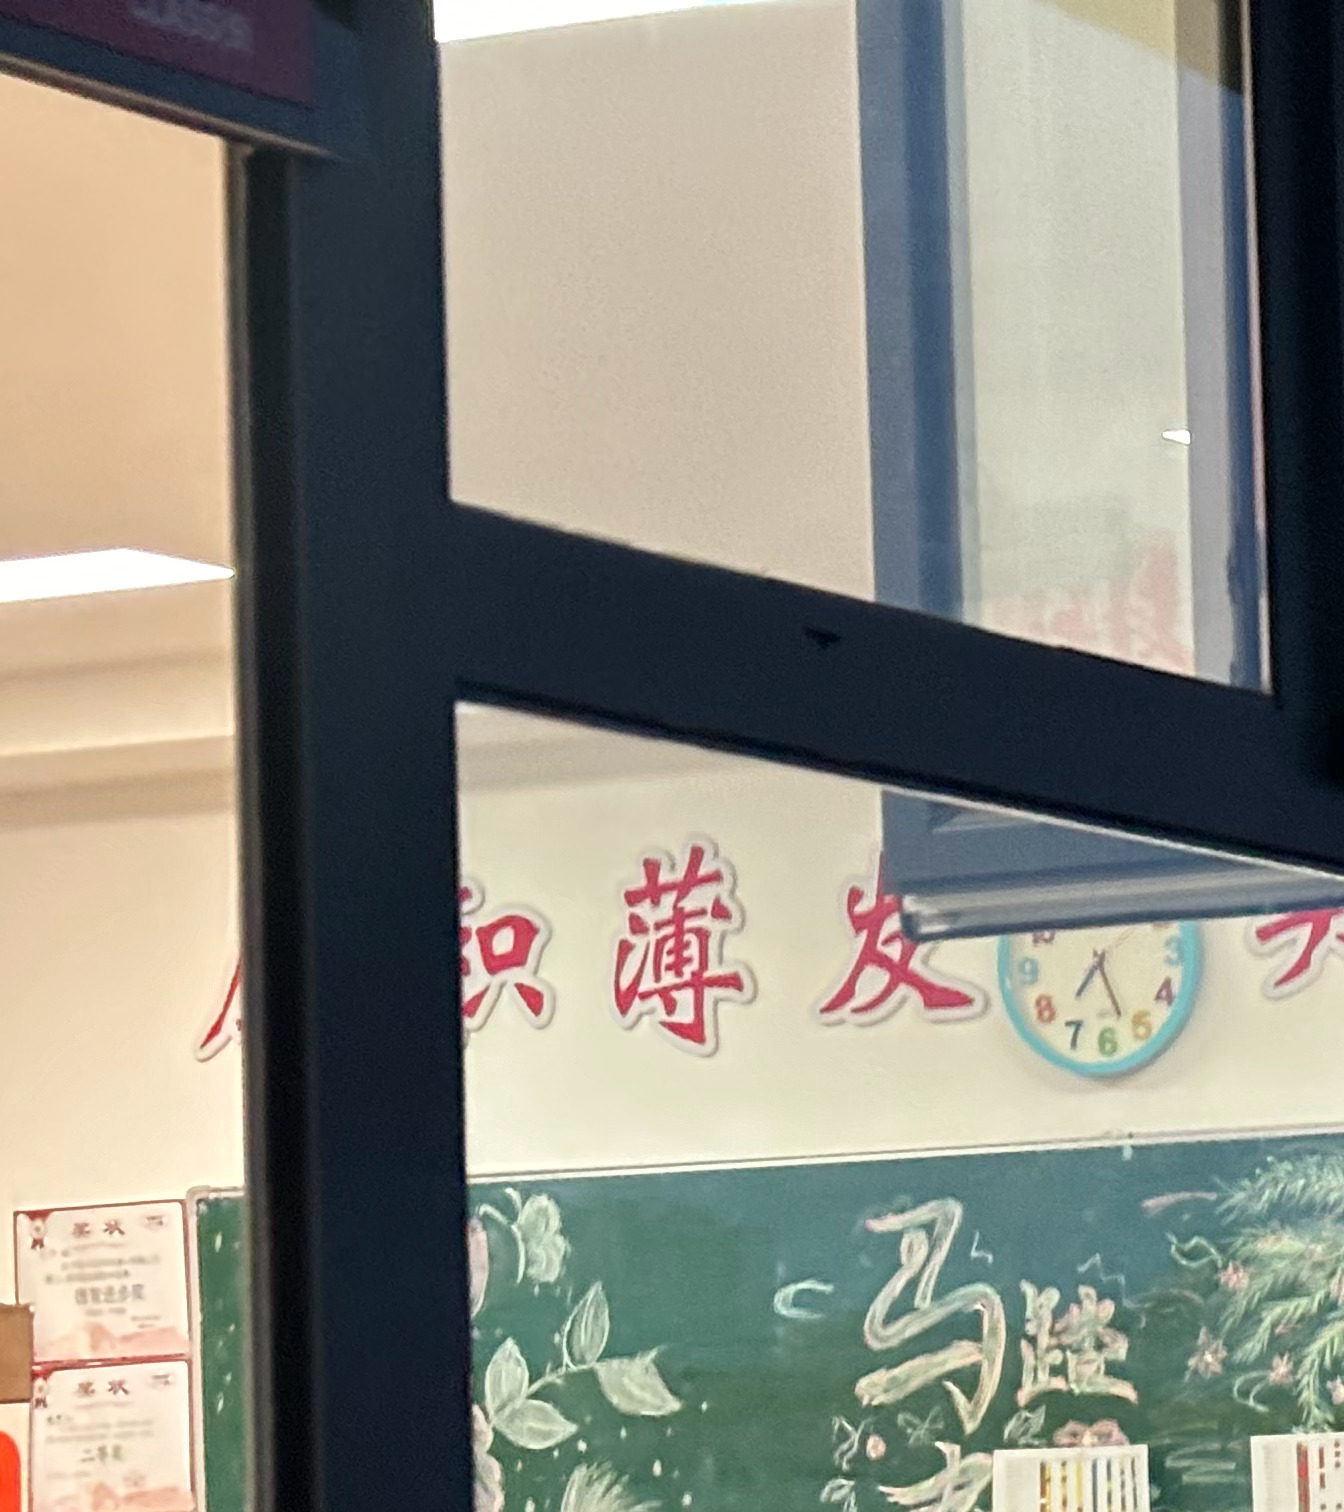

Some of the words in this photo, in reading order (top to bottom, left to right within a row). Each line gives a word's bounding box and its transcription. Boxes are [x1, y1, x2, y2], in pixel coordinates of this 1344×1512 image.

[198, 843, 976, 1052] 积薄发
[1153, 976, 1176, 1007] 4
[1034, 993, 1057, 1024] 8
[1063, 1019, 1085, 1050] 7
[1097, 1026, 1118, 1057] 6
